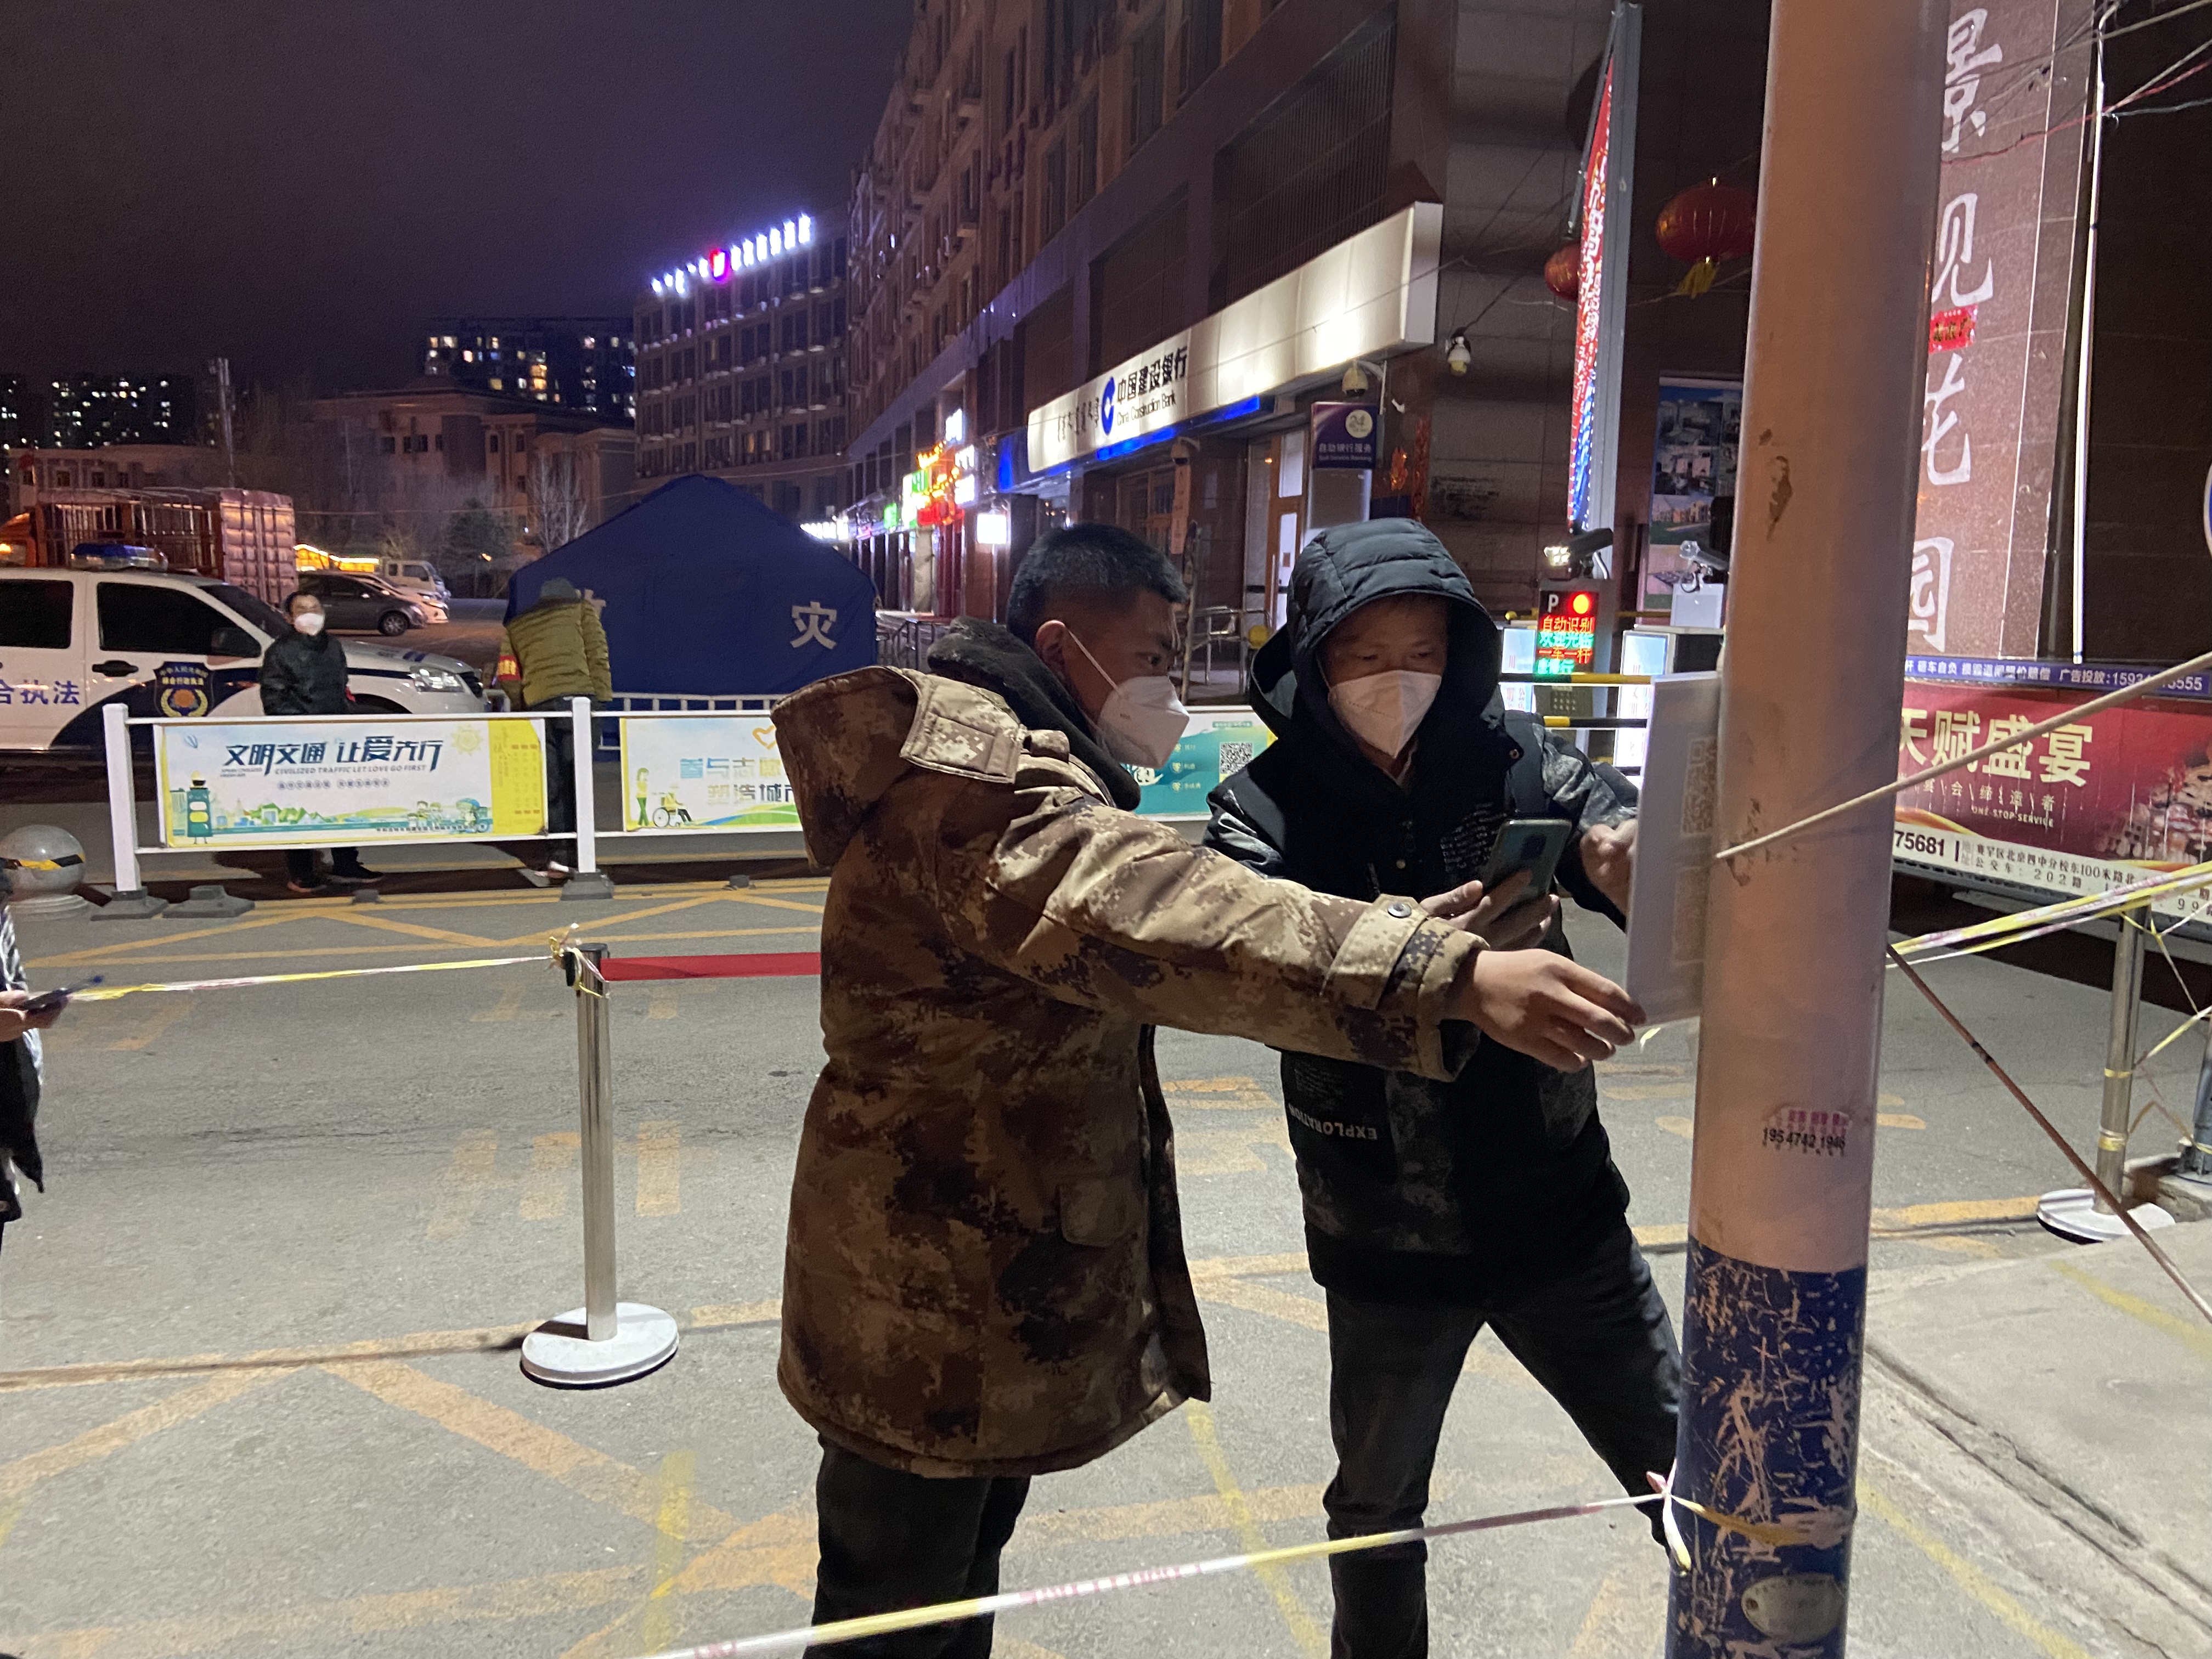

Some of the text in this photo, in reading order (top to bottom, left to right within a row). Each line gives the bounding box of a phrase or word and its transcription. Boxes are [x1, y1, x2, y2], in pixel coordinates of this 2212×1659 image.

[1117, 345, 1188, 404] 中国建设银行
[1548, 594, 1559, 613] P
[790, 601, 838, 650] 灾
[1542, 616, 1594, 633] 自动识别
[1539, 631, 1594, 648] 欢迎光临
[1538, 646, 1593, 664] 一车一杆
[223, 735, 444, 776] 文明交通 让爱先行
[1894, 830, 1945, 857] 75681
